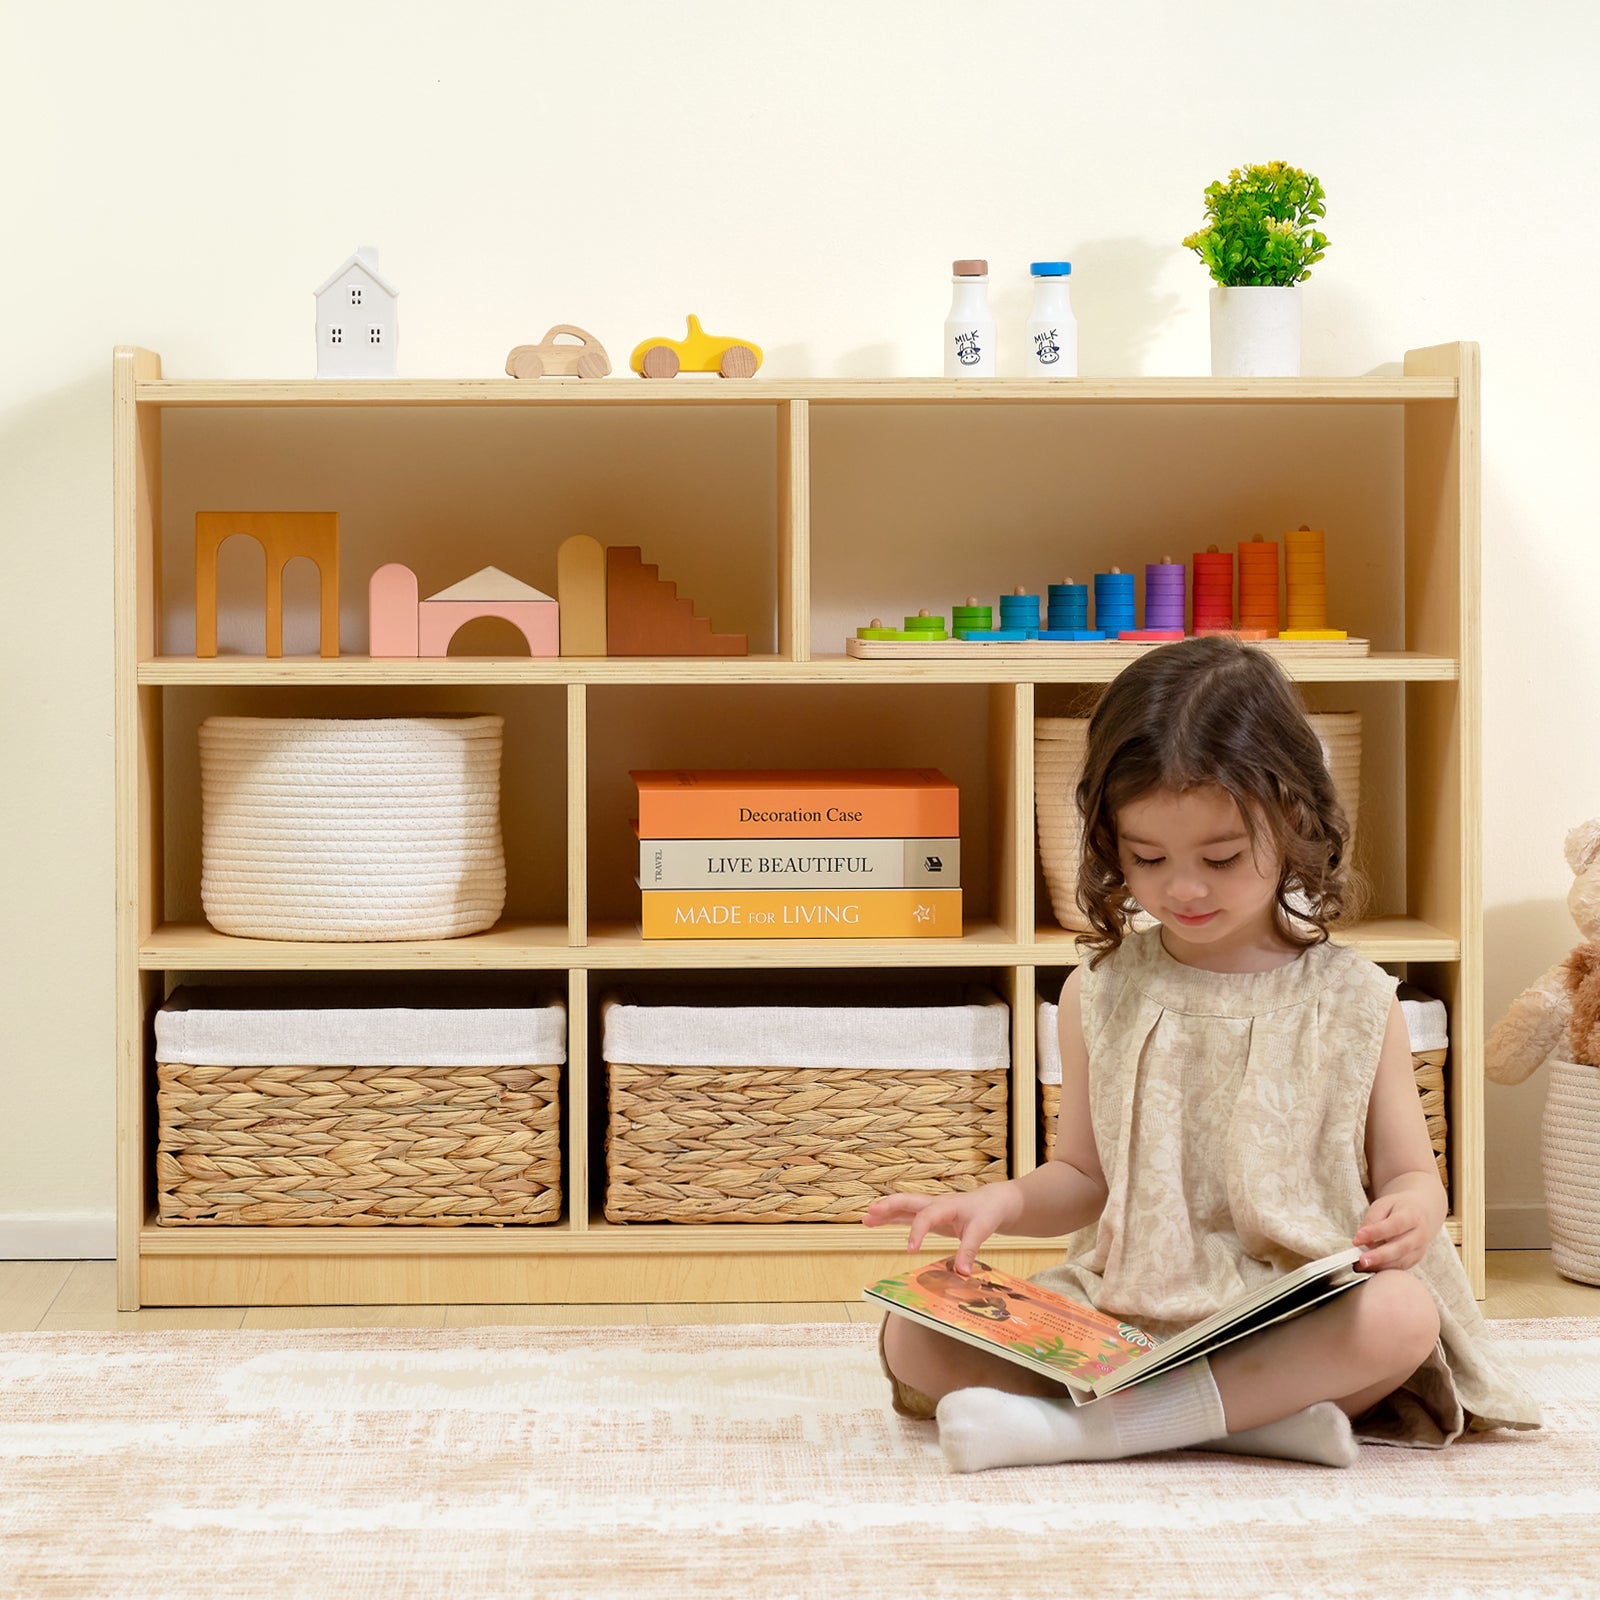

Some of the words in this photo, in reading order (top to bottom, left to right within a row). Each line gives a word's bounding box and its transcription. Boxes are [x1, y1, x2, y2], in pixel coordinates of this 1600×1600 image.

[954, 329, 979, 344] MILK
[1034, 328, 1058, 343] MILK
[739, 807, 822, 822] Decoration
[826, 807, 863, 822] Case
[707, 857, 752, 873] LIVE
[758, 856, 873, 873] BEAUTIFUL
[674, 906, 741, 924] MADE
[748, 911, 775, 924] FOR
[783, 905, 859, 924] LIVING
